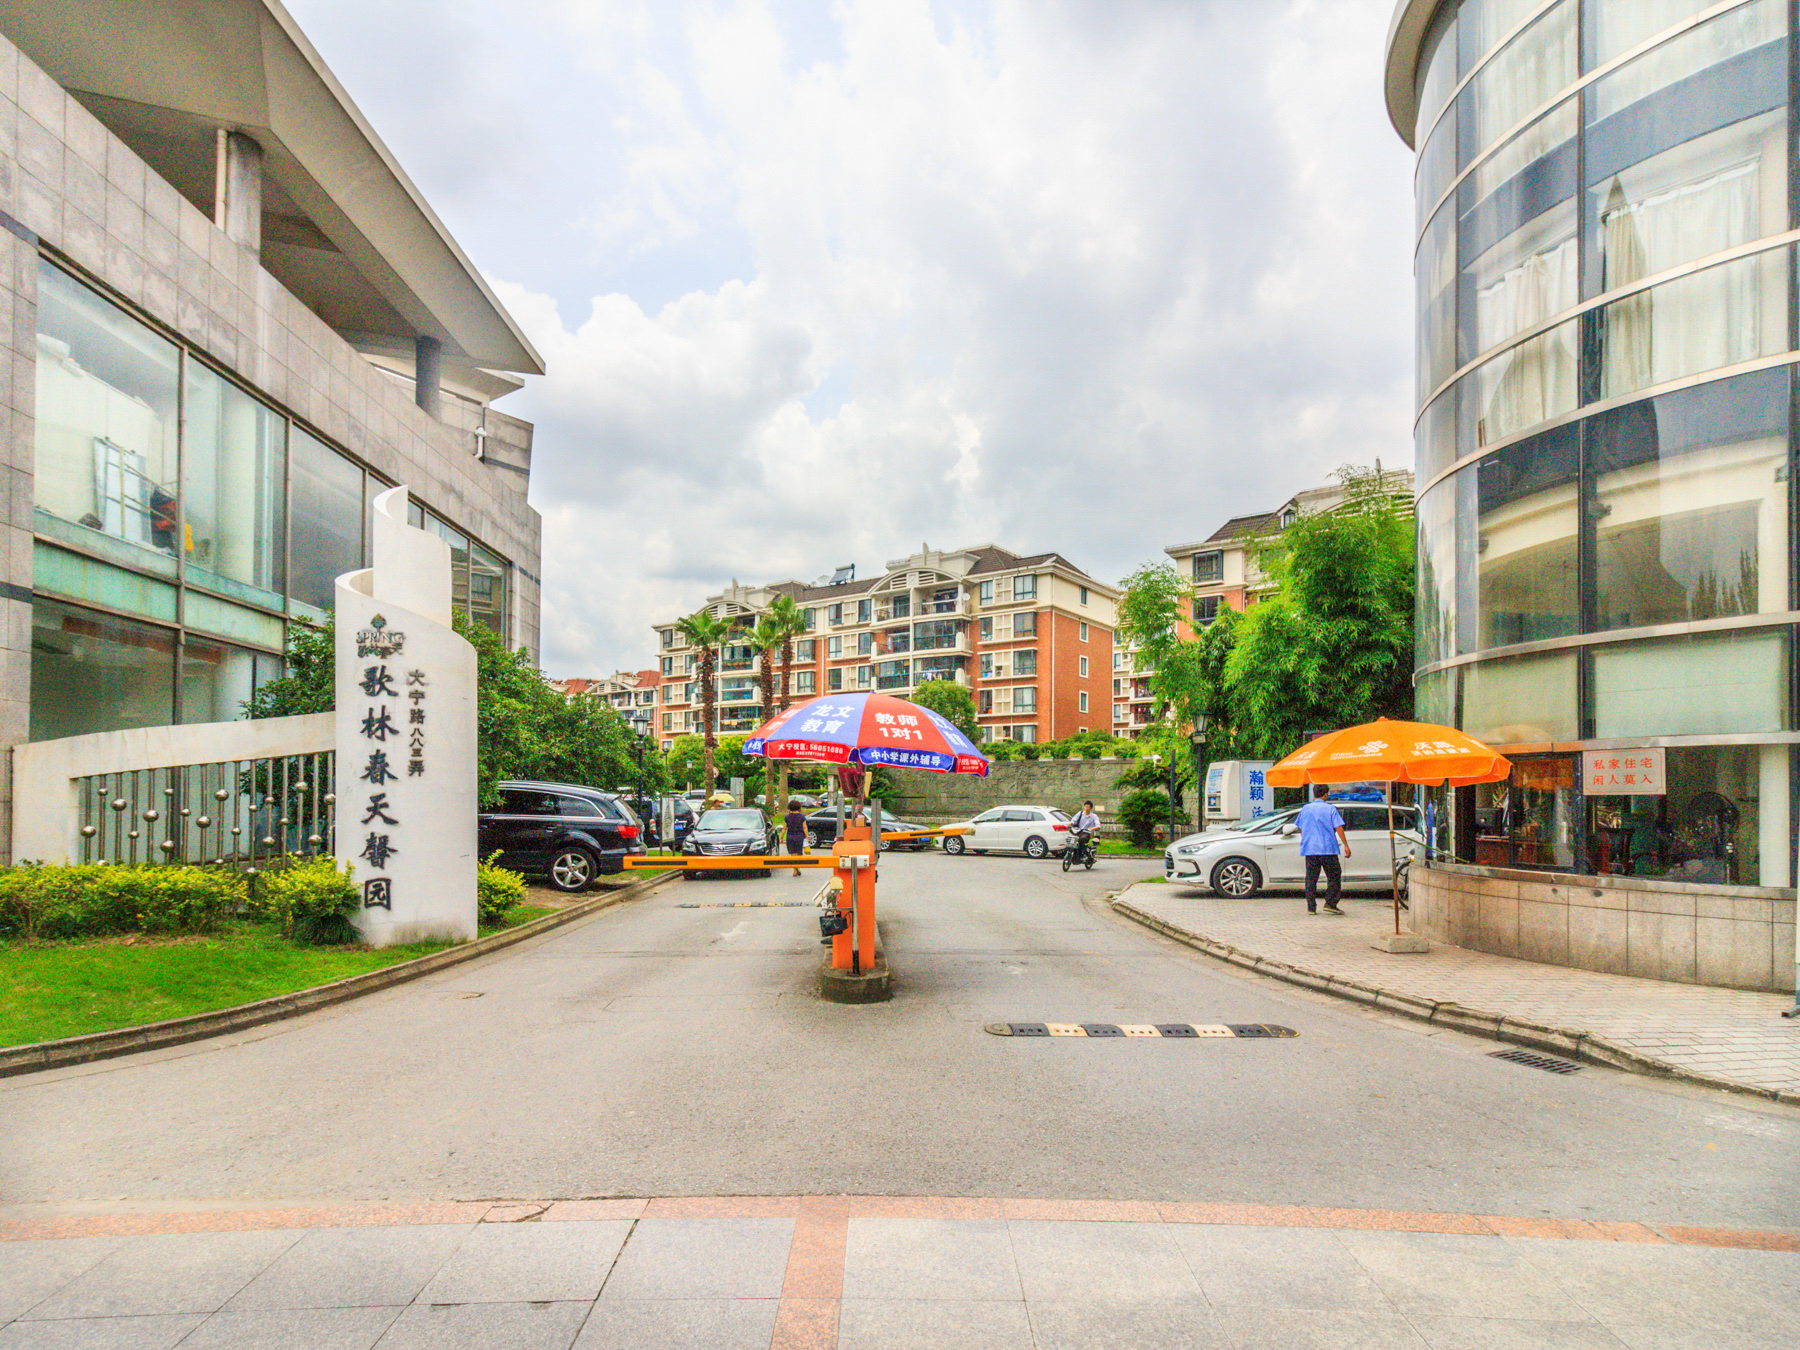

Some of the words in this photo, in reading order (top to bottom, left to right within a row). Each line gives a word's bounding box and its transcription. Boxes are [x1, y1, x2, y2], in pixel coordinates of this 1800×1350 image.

[356, 632, 406, 643] SPRING
[811, 704, 855, 718] 龙文
[406, 669, 426, 777] 大宁路八八三弄
[800, 718, 845, 734] 教育
[875, 713, 918, 727] 教师
[879, 727, 923, 740] 1对1
[871, 750, 941, 766] 中小学课外辅导
[1593, 757, 1653, 770] 私家住宅
[1249, 770, 1264, 801] 瀚颖
[1593, 774, 1653, 785] 闲人莫入
[359, 665, 399, 911] 歌林春天馨园
